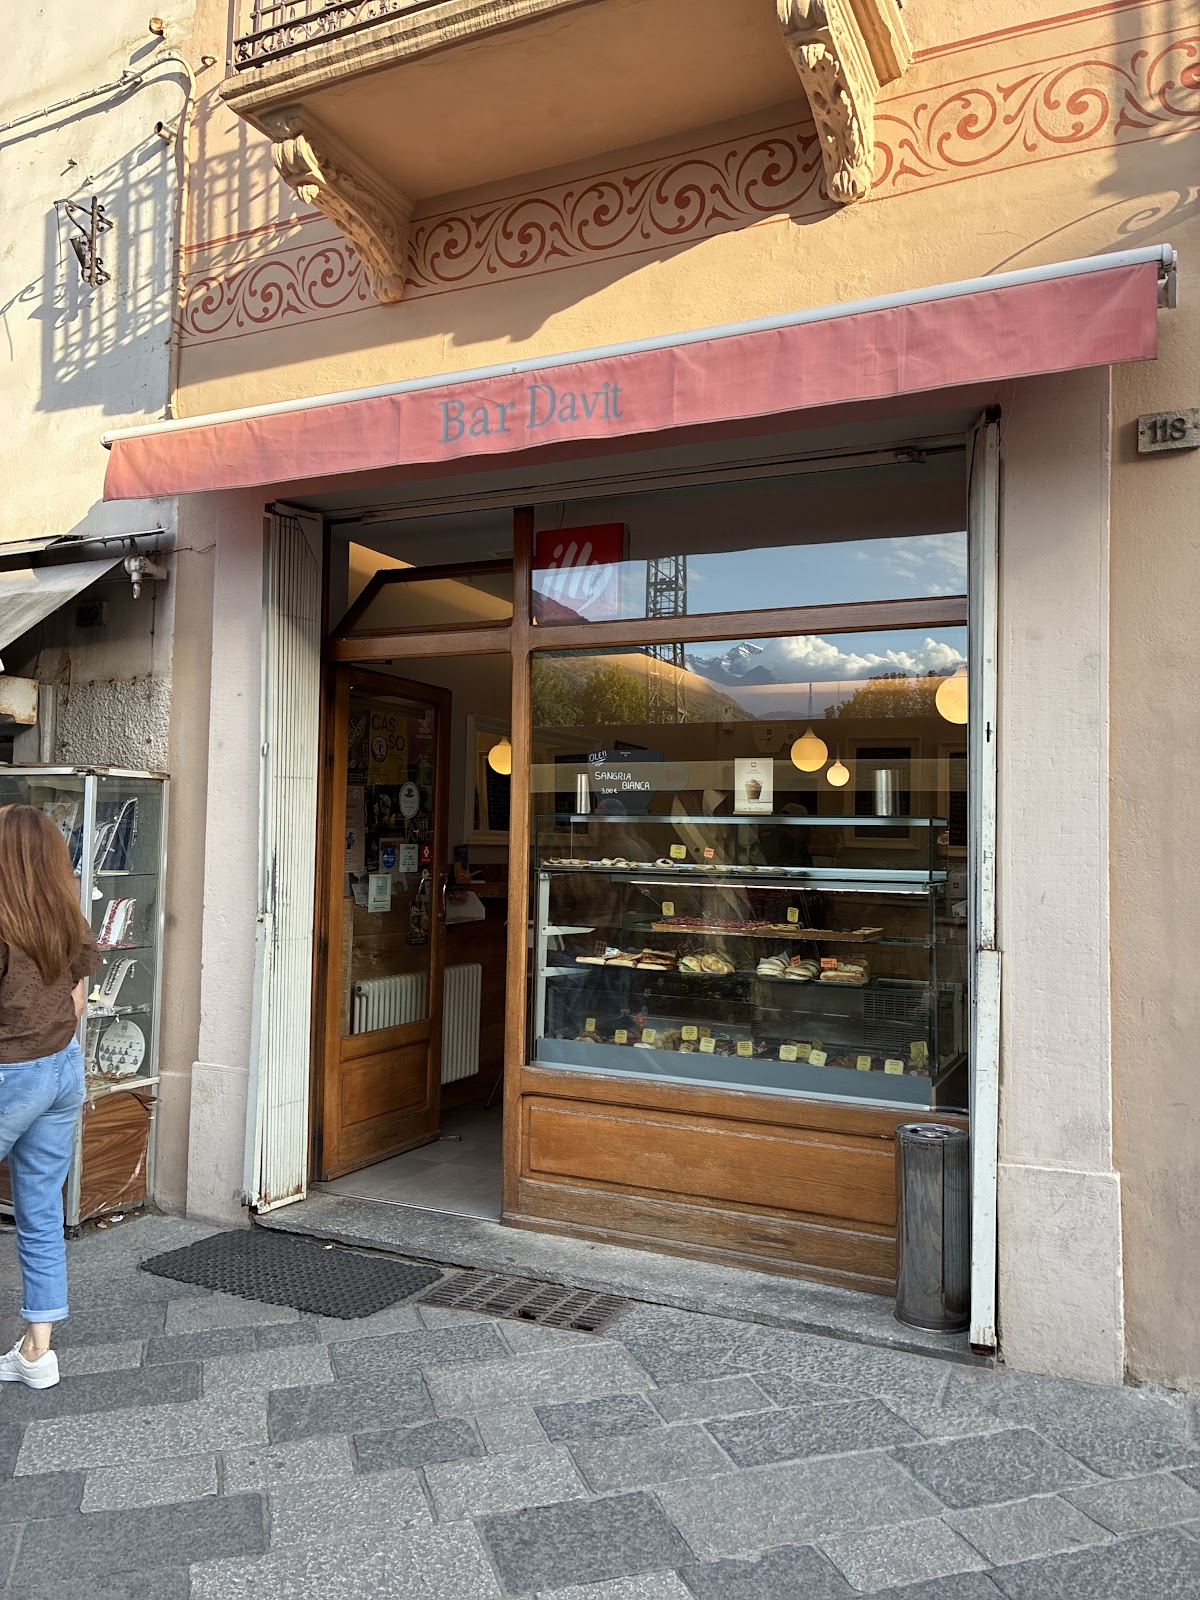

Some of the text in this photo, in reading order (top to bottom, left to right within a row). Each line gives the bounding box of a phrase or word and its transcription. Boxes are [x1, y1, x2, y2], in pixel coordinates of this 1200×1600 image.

[438, 381, 624, 444] Bar Davit
[540, 541, 614, 613] illy
[372, 714, 396, 734] CAS
[388, 734, 406, 752] SO
[594, 771, 632, 781] SANGRIA
[622, 781, 651, 791] BIANCA
